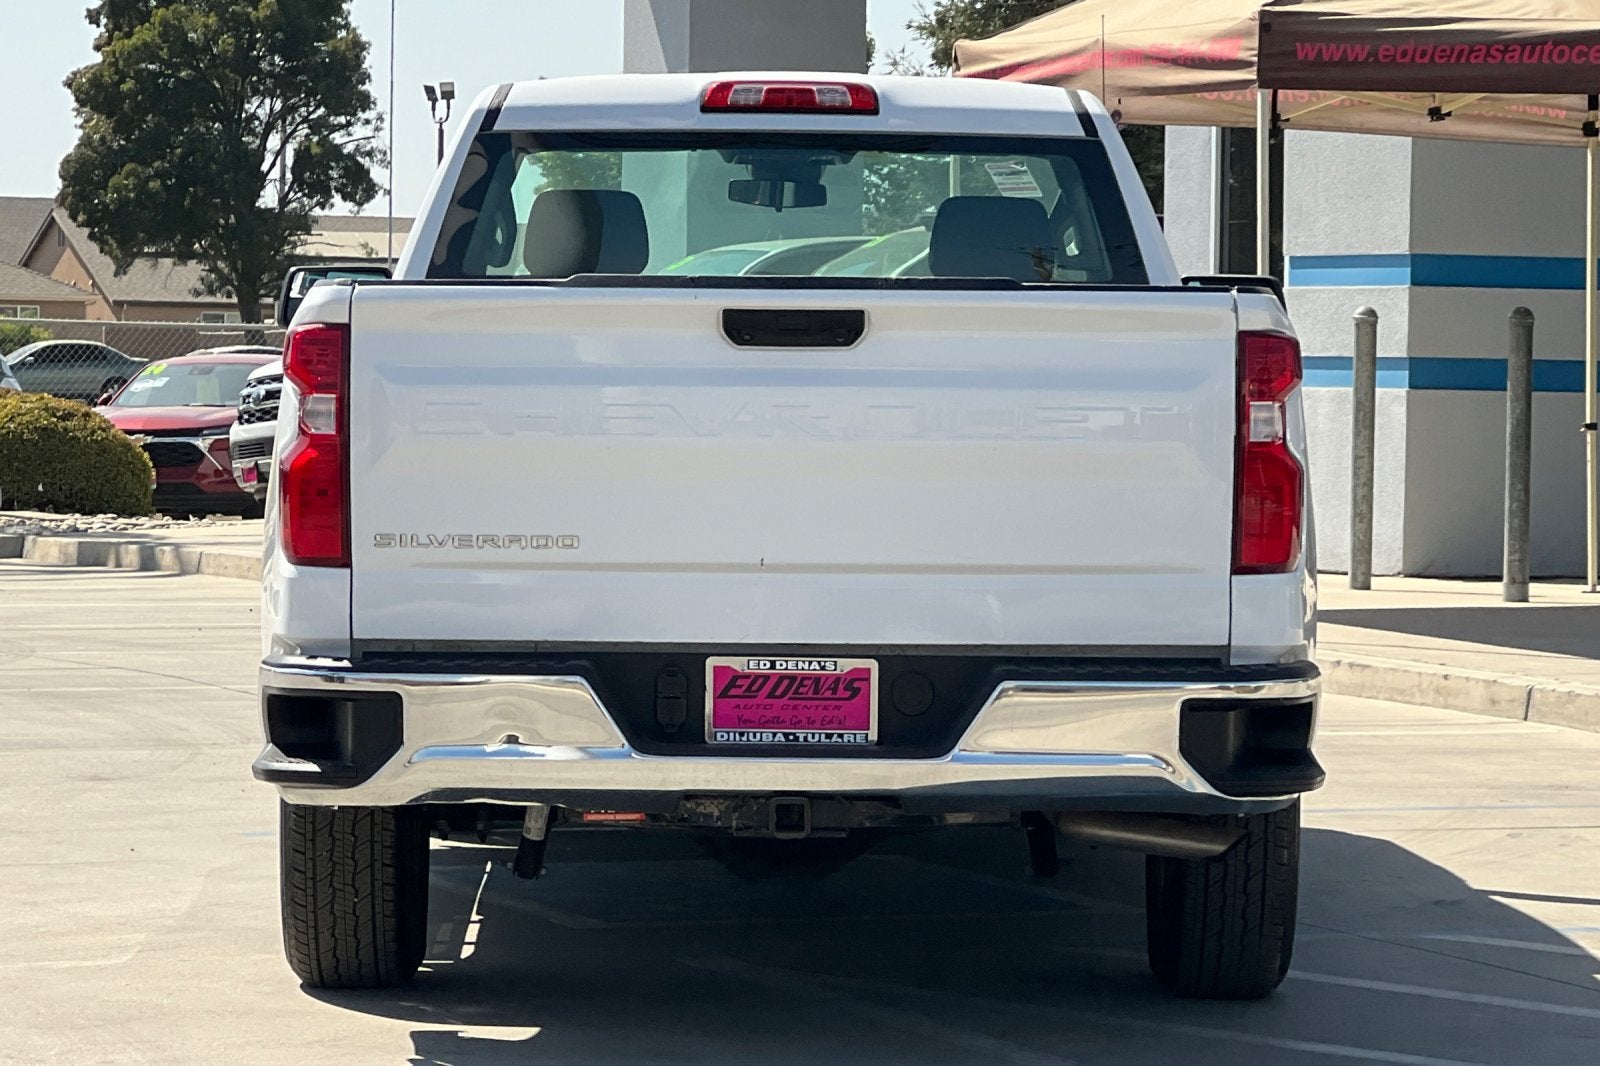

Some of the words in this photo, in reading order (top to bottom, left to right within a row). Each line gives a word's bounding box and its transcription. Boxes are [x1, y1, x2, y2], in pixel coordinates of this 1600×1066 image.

[374, 533, 580, 550] SILVERADO
[748, 660, 772, 670] ED
[775, 660, 836, 671] DENA'S
[716, 674, 771, 699] ED
[764, 675, 869, 701] DENA'S
[737, 714, 756, 726] You
[758, 714, 787, 727] Gotta
[789, 715, 802, 727] Go
[716, 732, 786, 742] DINUBA
[795, 733, 867, 743] TULARE
